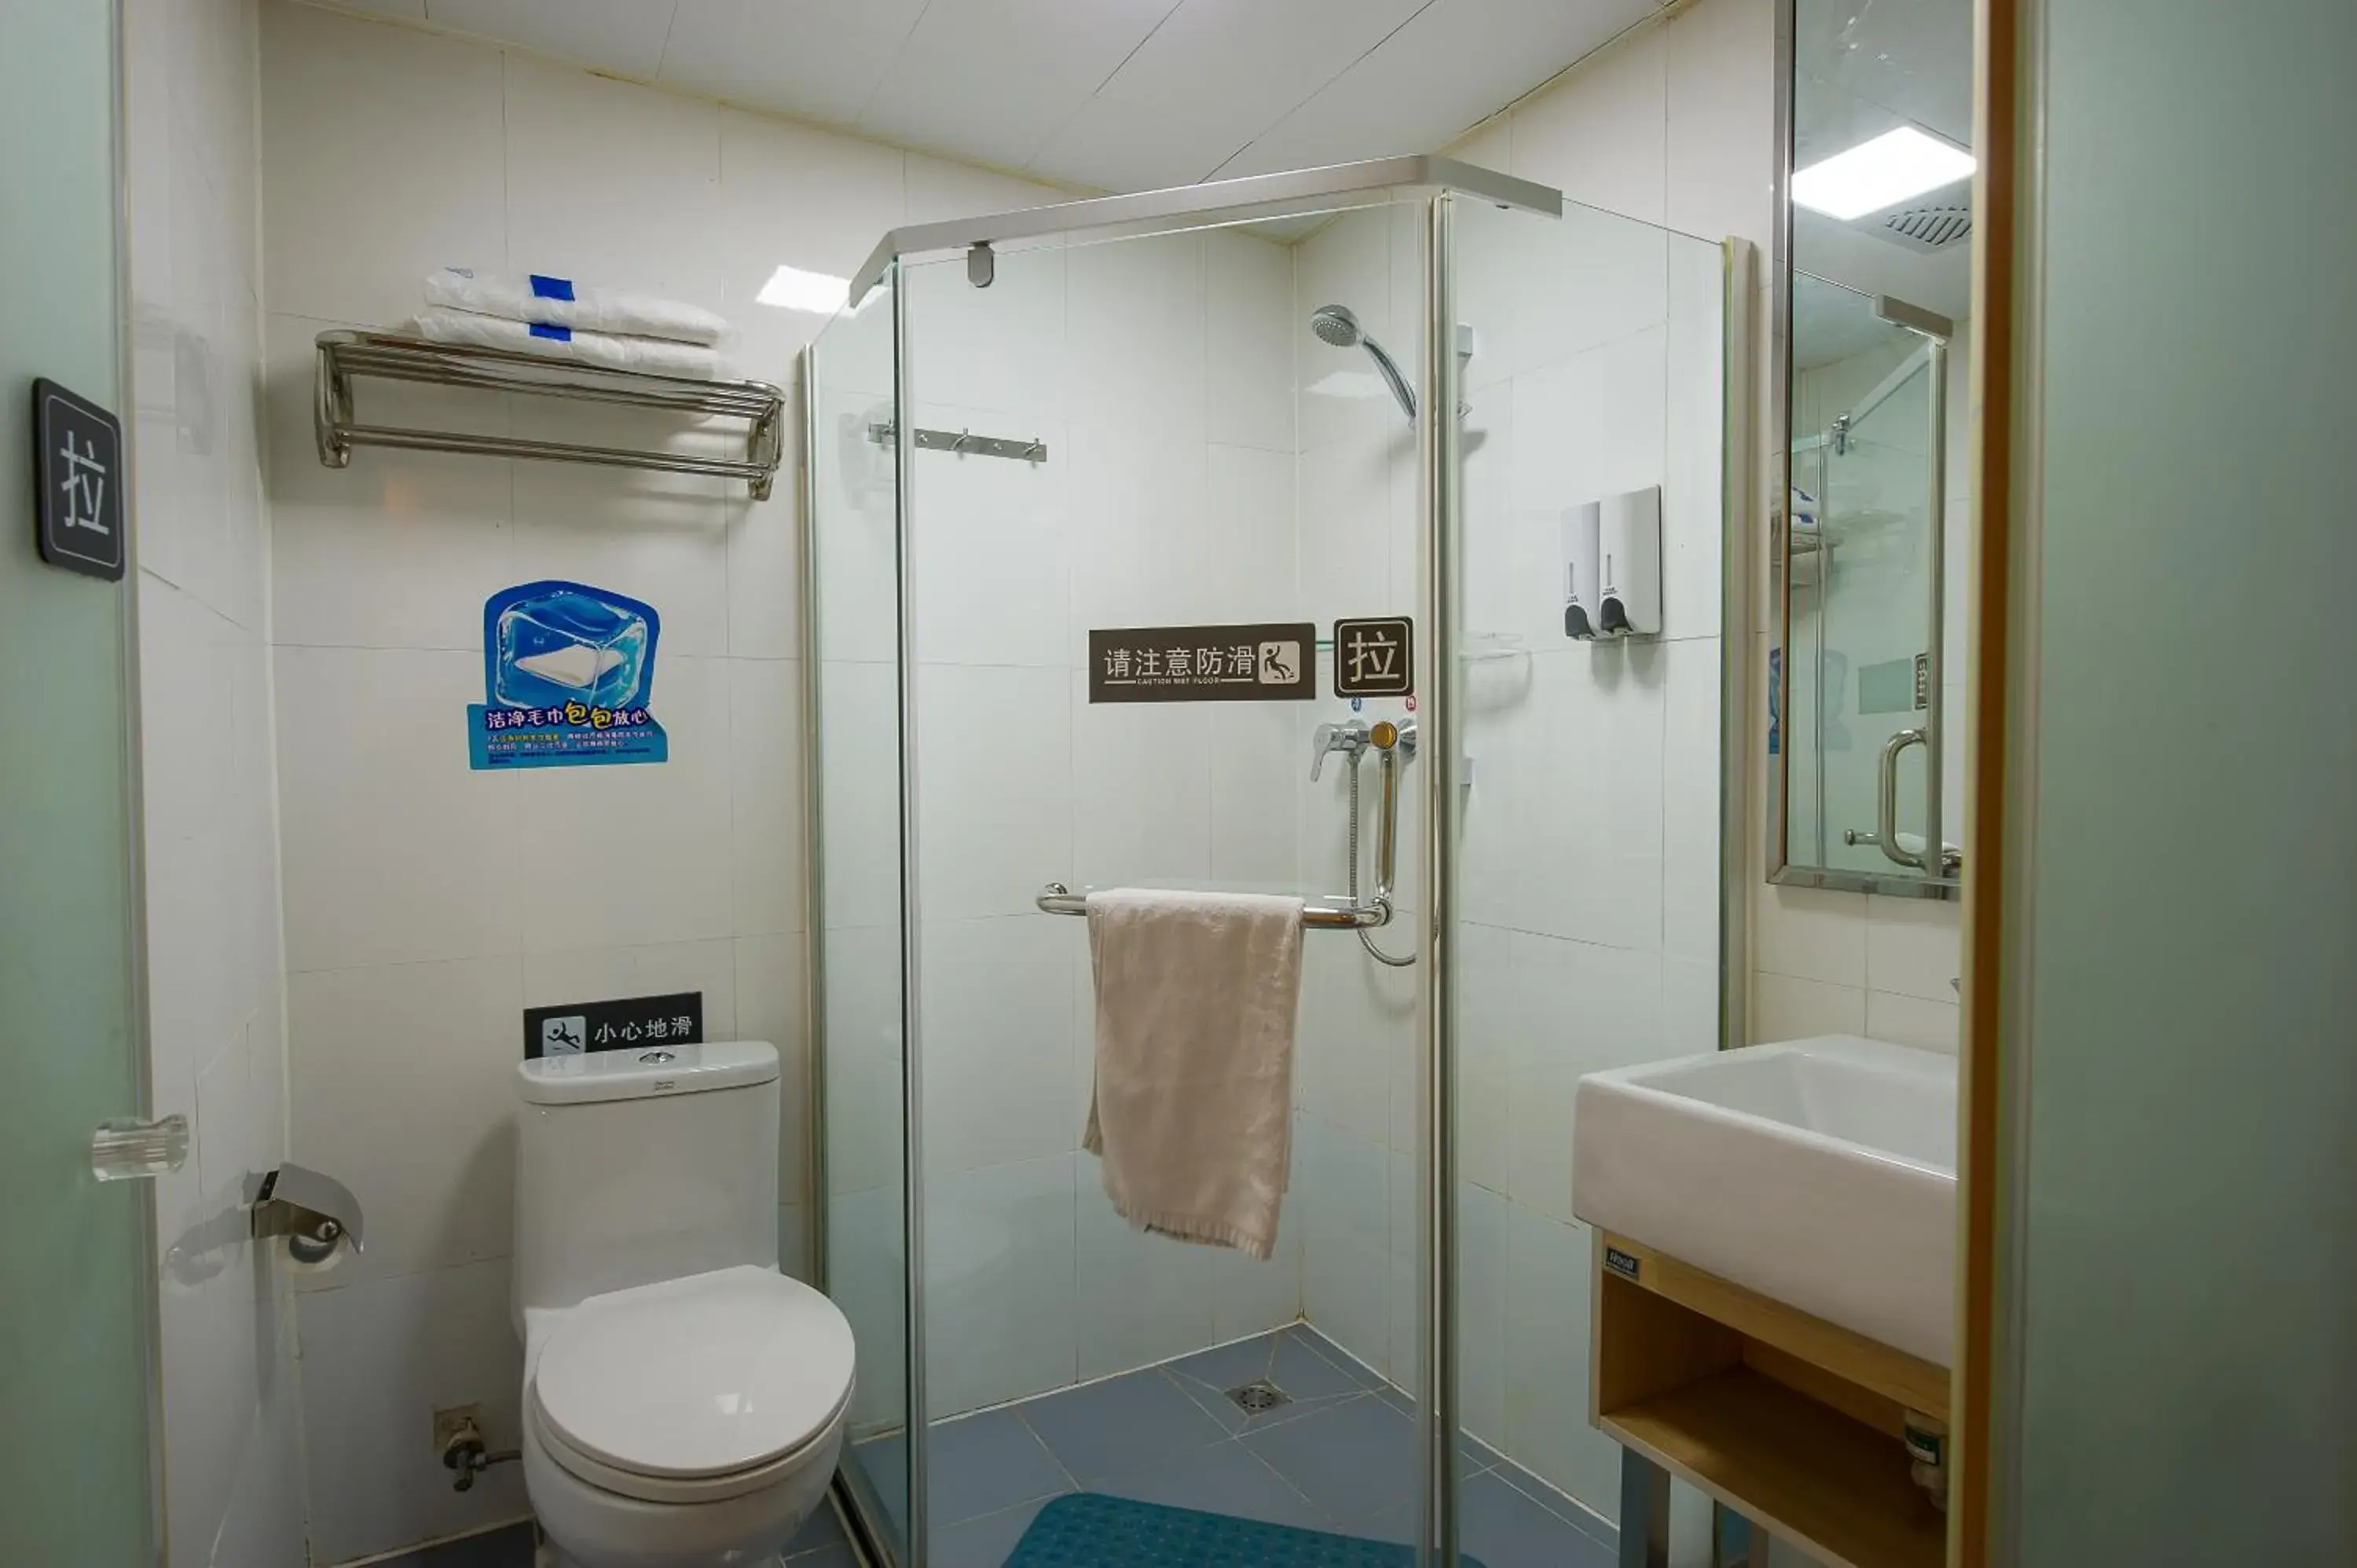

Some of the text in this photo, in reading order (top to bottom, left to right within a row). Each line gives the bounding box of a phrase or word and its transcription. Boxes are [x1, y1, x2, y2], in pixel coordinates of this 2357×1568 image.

[60, 430, 110, 536] 拉
[1104, 645, 1255, 677] 请注意防滑
[1347, 631, 1401, 683] 拉
[594, 1016, 692, 1044] 小心地滑
